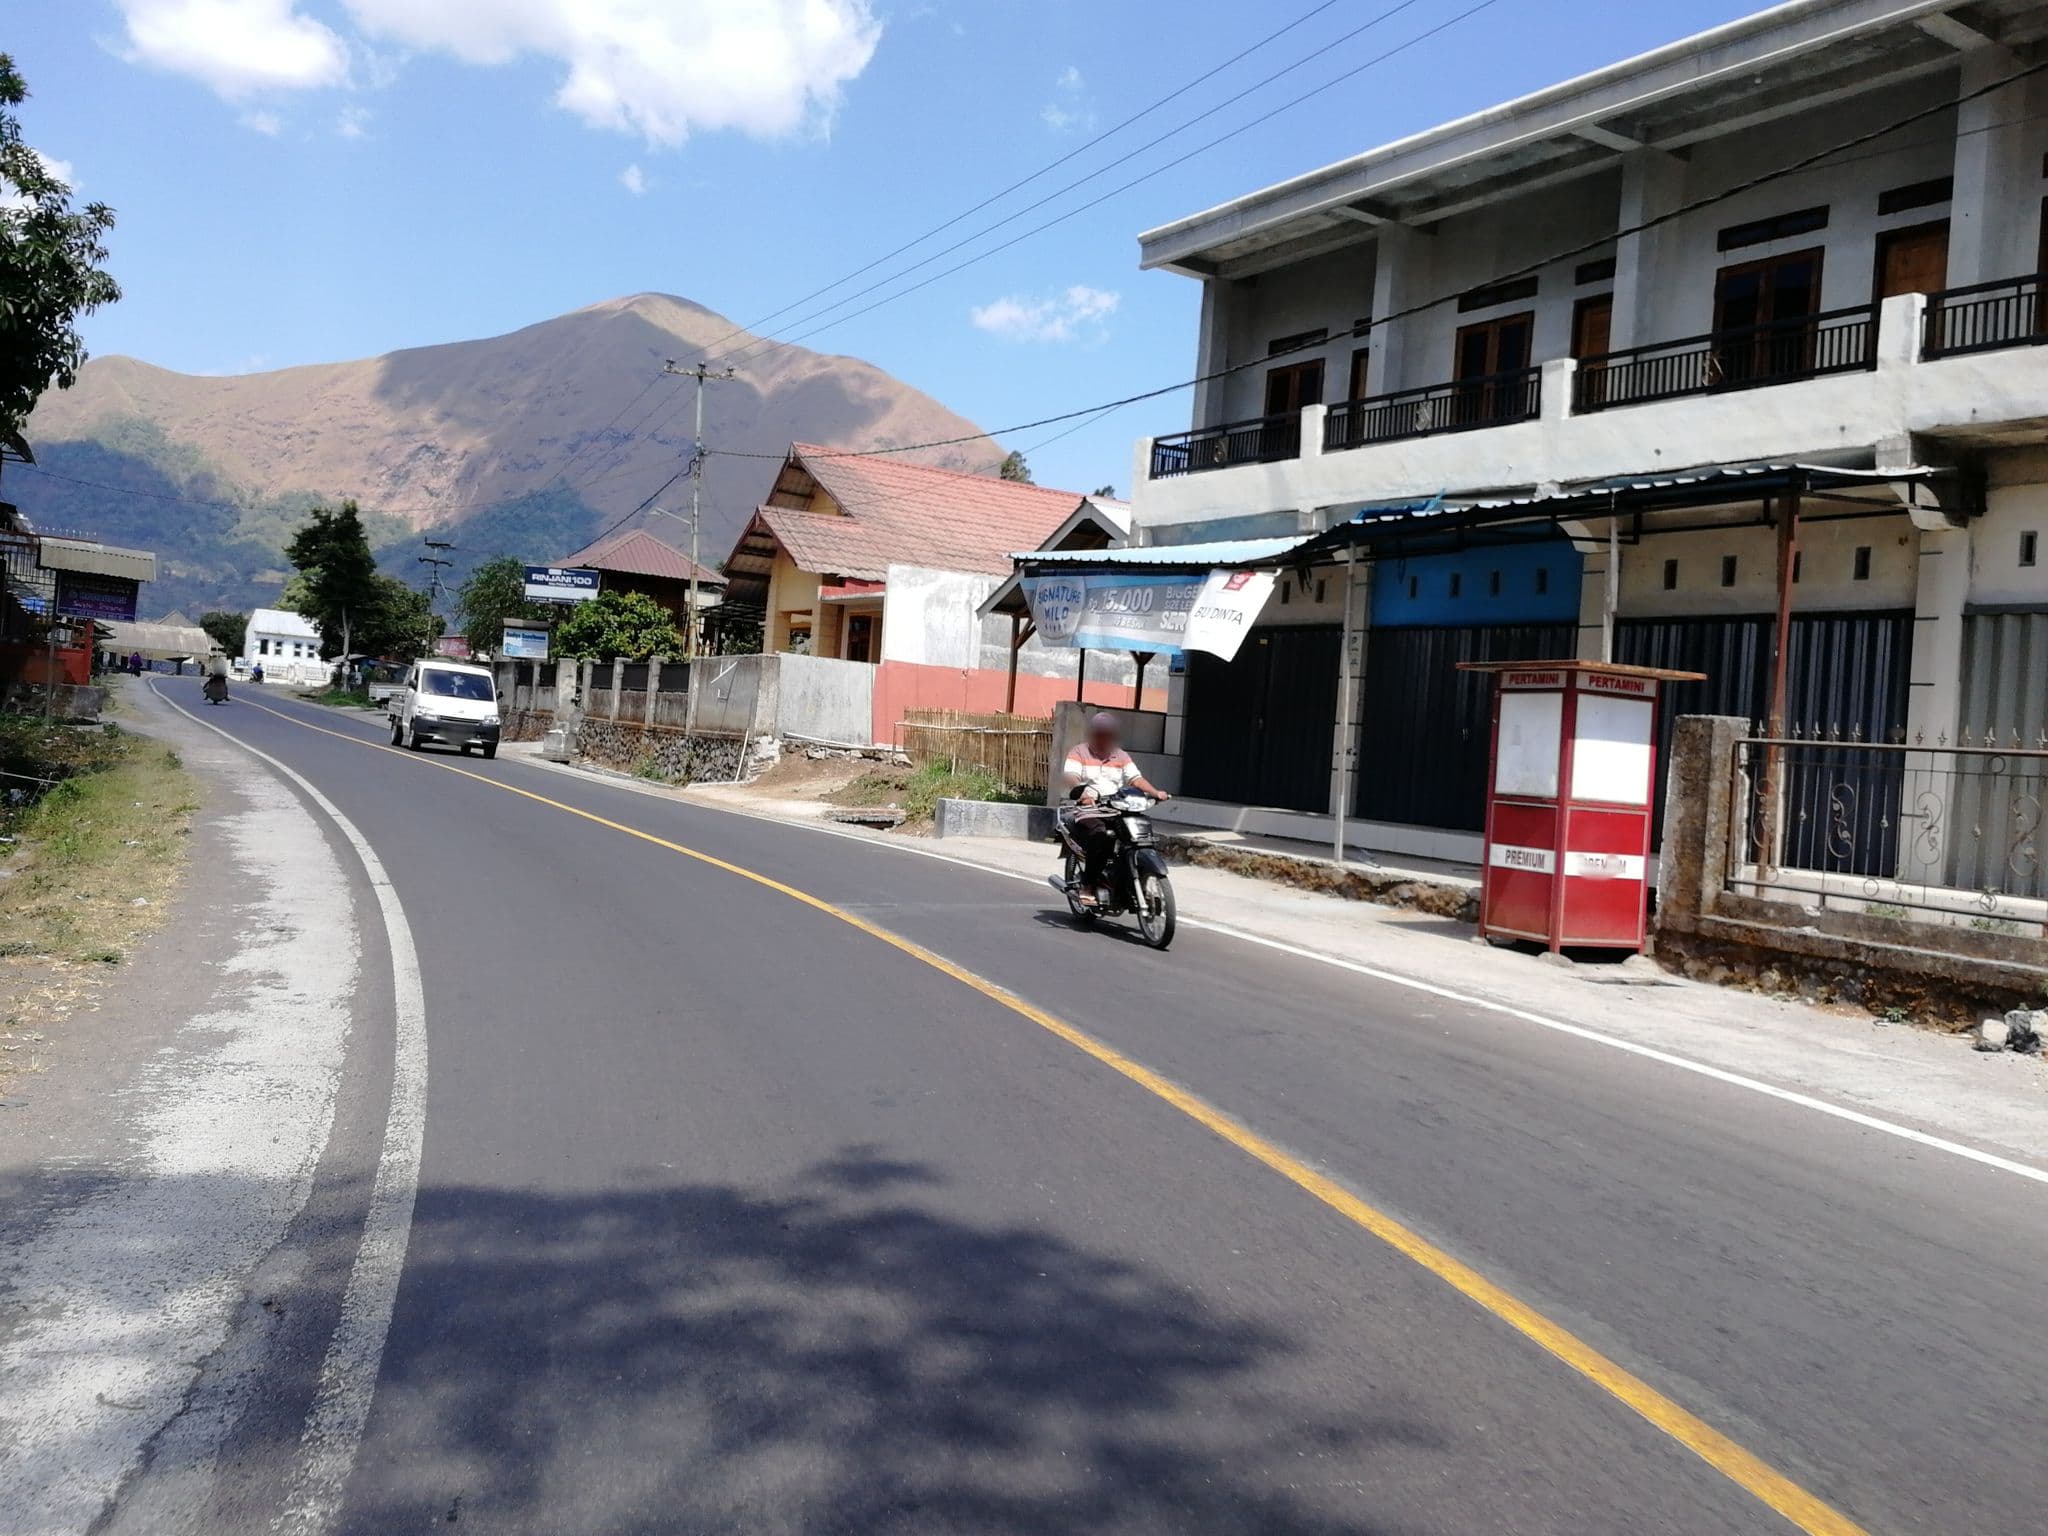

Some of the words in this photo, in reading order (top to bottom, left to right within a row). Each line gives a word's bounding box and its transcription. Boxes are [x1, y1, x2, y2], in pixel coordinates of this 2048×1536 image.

[532, 573, 571, 583] RINJANI
[572, 577, 592, 585] 100
[1038, 585, 1081, 604] SIGNATURE
[1102, 587, 1153, 612] 15.000
[1165, 585, 1203, 599] BIGGE
[1044, 606, 1070, 620] MILD
[1509, 673, 1559, 684] PERTAMINI
[1588, 675, 1645, 693] PERTAMINI
[1504, 850, 1546, 869] PREMIUM
